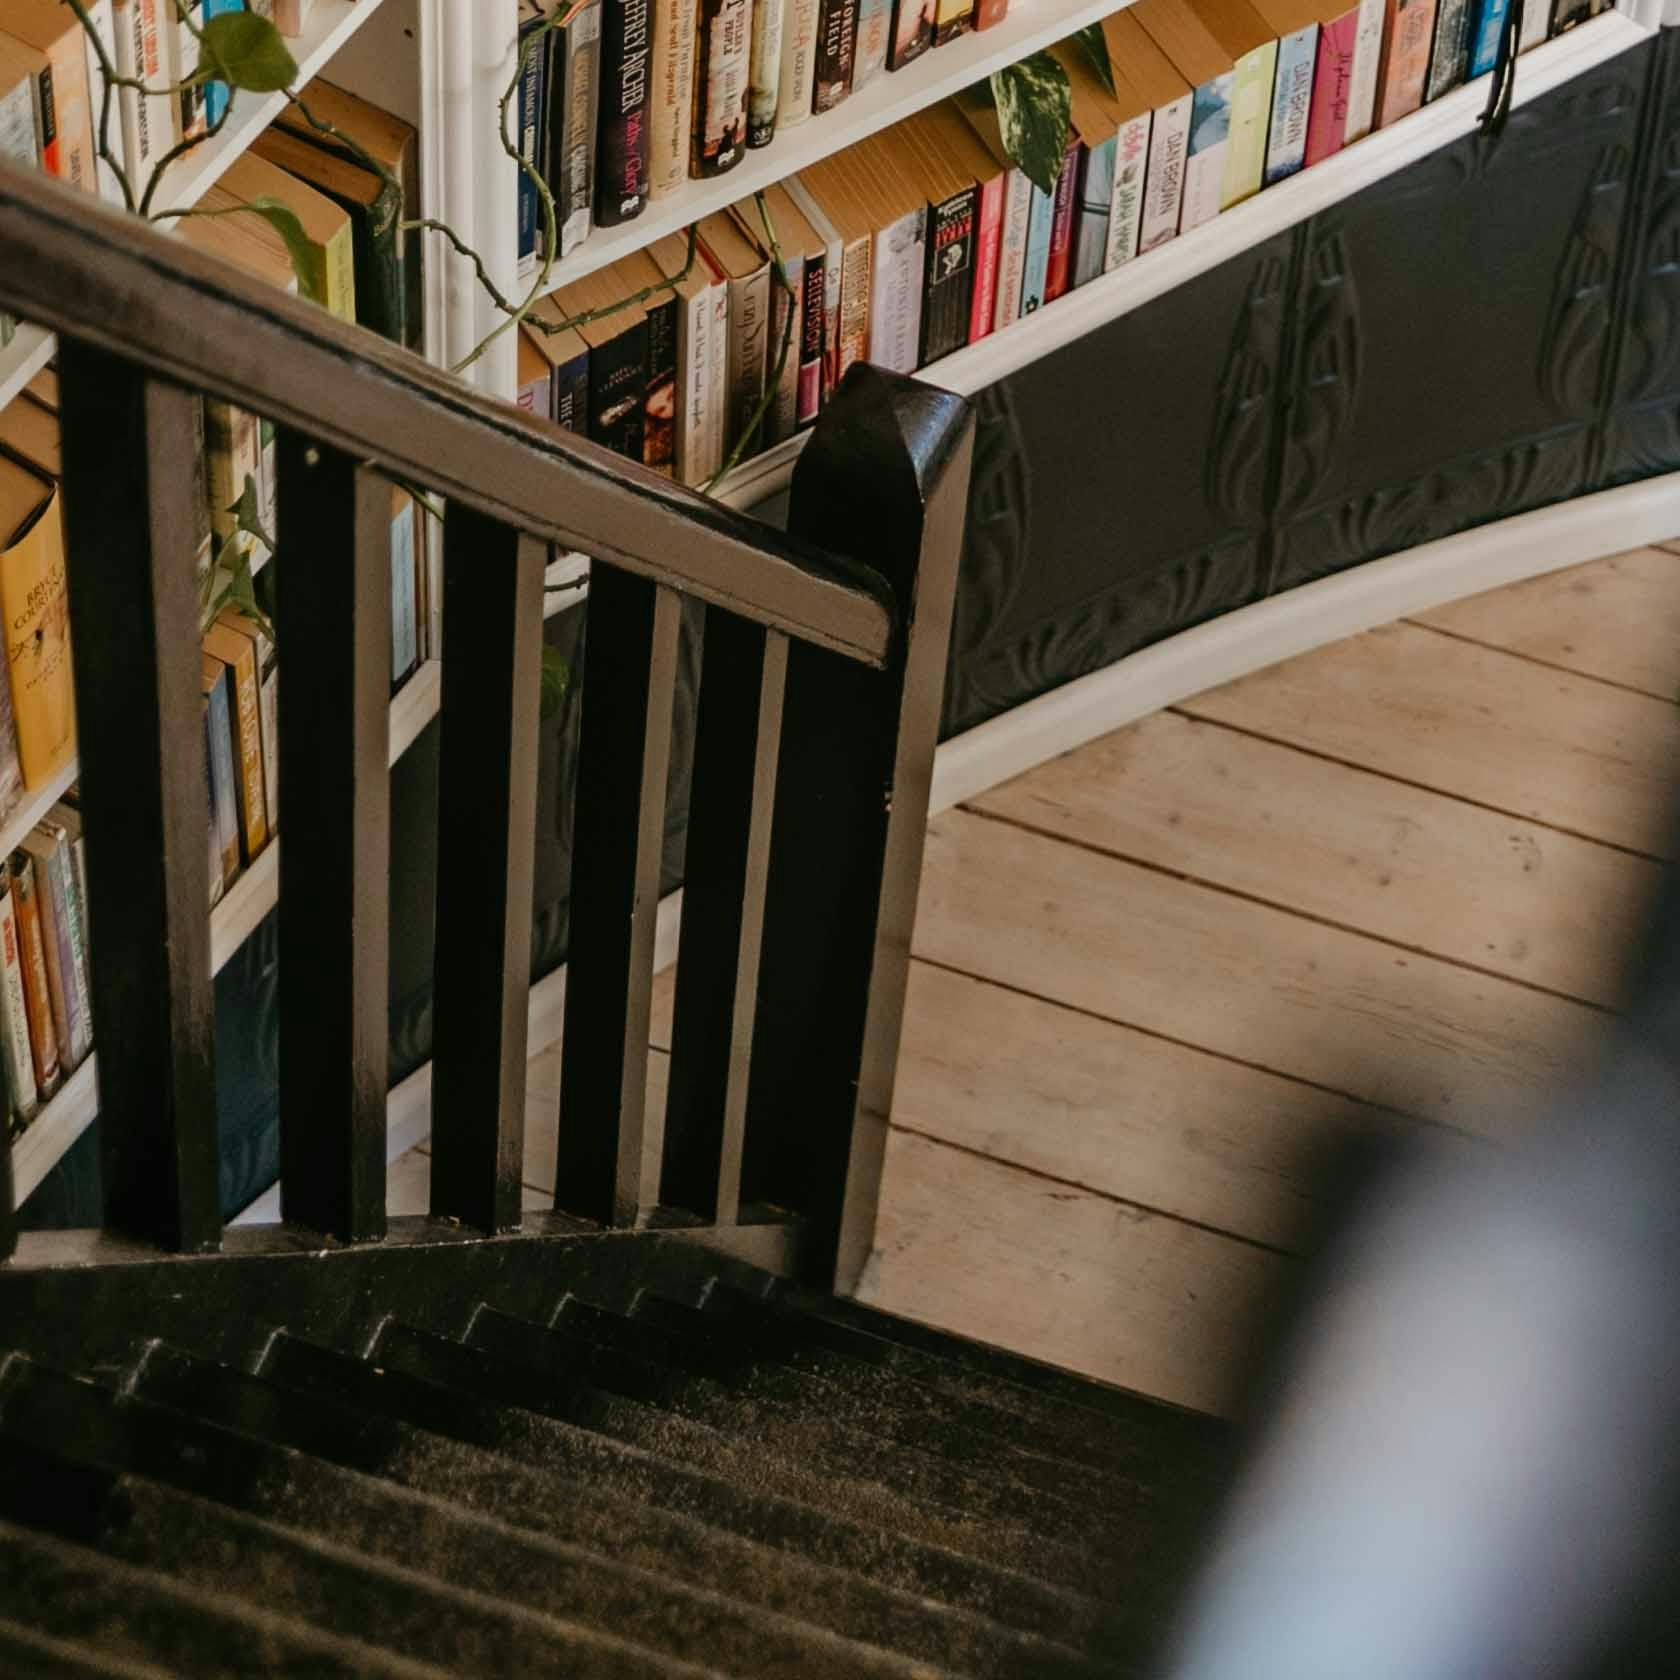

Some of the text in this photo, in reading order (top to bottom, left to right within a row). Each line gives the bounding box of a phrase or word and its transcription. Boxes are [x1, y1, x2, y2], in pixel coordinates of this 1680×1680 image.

[826, 11, 842, 56] FIELD
[619, 51, 648, 114] ARCHER
[1287, 61, 1310, 145] DAN BROWN
[560, 392, 573, 420] THE
